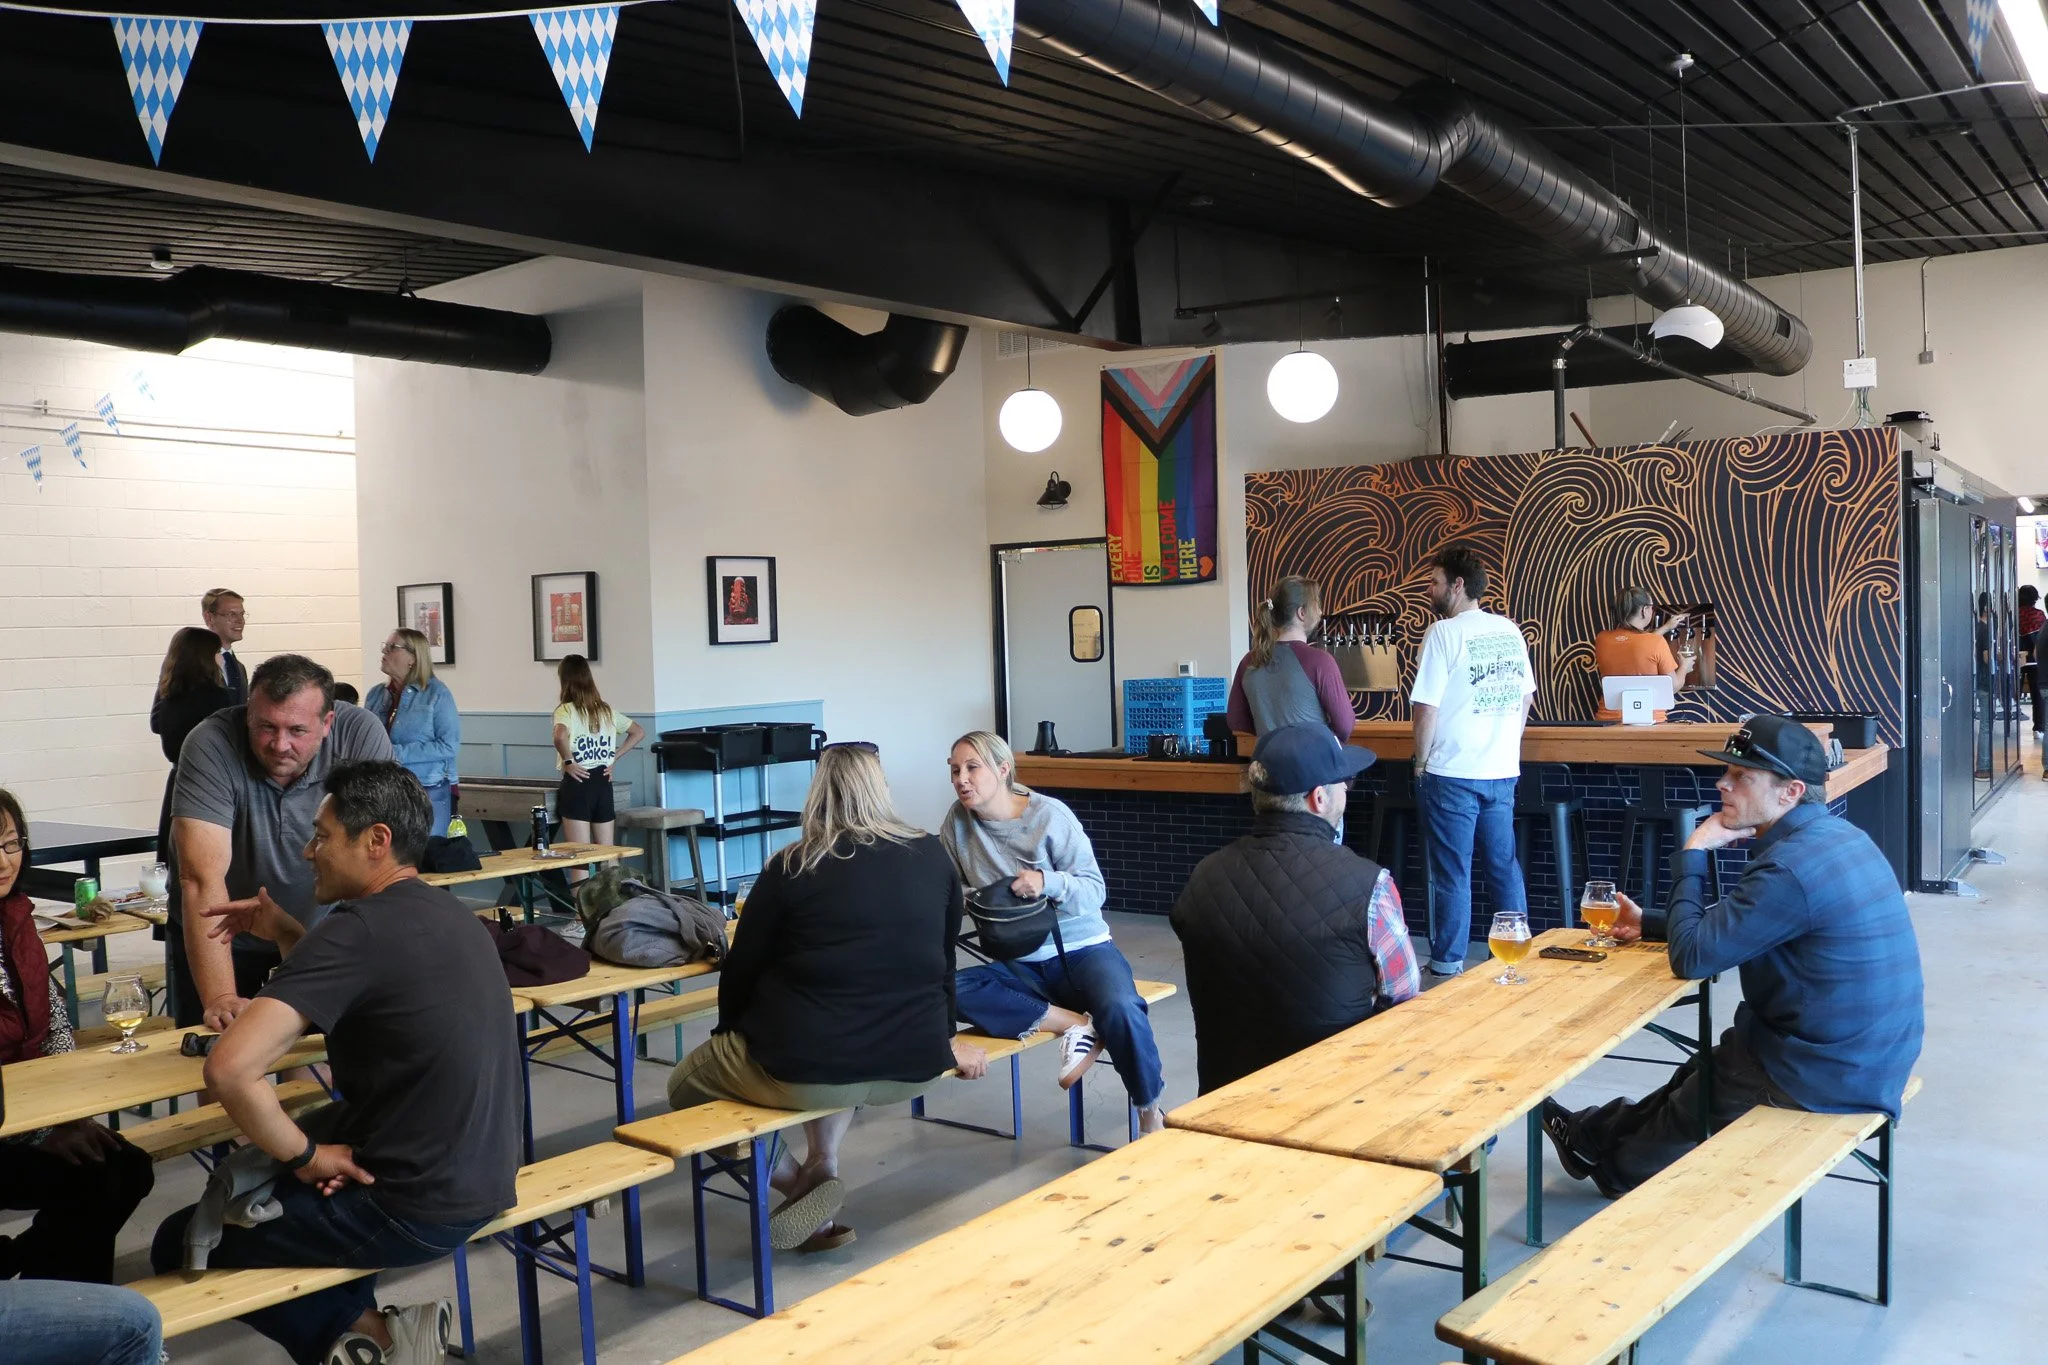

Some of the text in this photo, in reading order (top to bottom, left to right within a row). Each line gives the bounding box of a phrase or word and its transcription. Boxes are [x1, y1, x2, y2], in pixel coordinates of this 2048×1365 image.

[1159, 498, 1178, 580] WELCOME
[1109, 534, 1123, 581] EVERY
[1124, 551, 1143, 583] ONE
[1144, 565, 1160, 581] IS
[1178, 537, 1198, 579] HERE
[572, 747, 616, 763] COOKOF
[577, 736, 611, 752] CHILI
